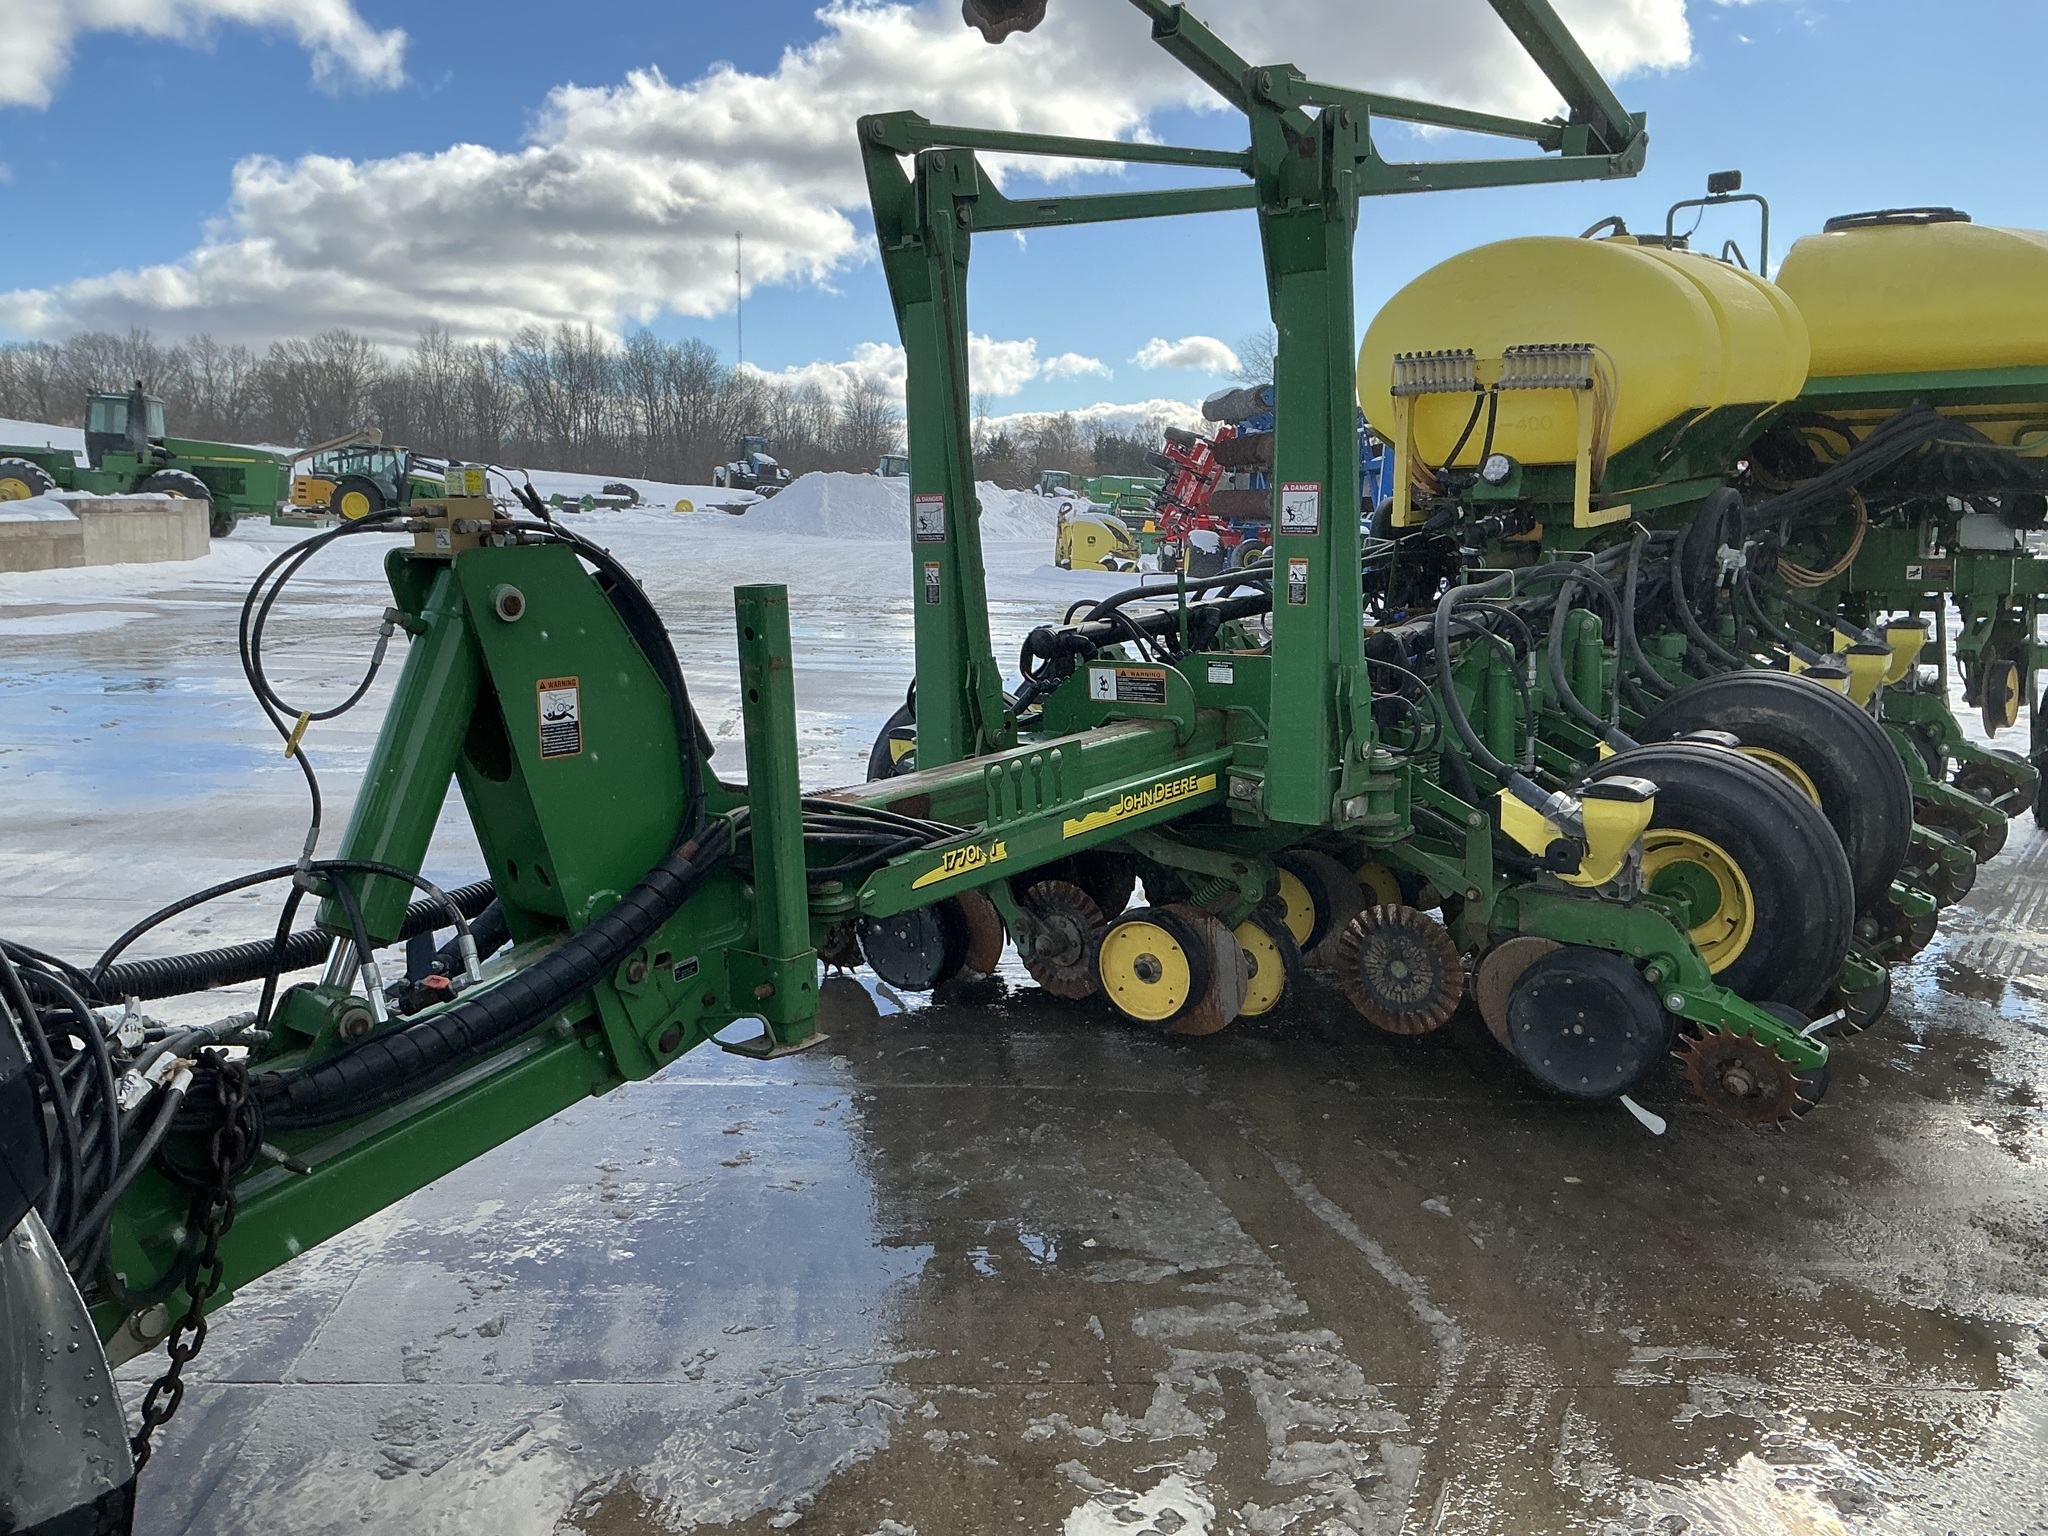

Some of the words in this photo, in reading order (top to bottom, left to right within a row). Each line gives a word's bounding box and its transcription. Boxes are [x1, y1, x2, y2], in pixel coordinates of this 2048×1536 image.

[548, 679, 577, 689] WARNING
[1116, 789, 1153, 815] JOHN
[1154, 775, 1198, 802] DEERE
